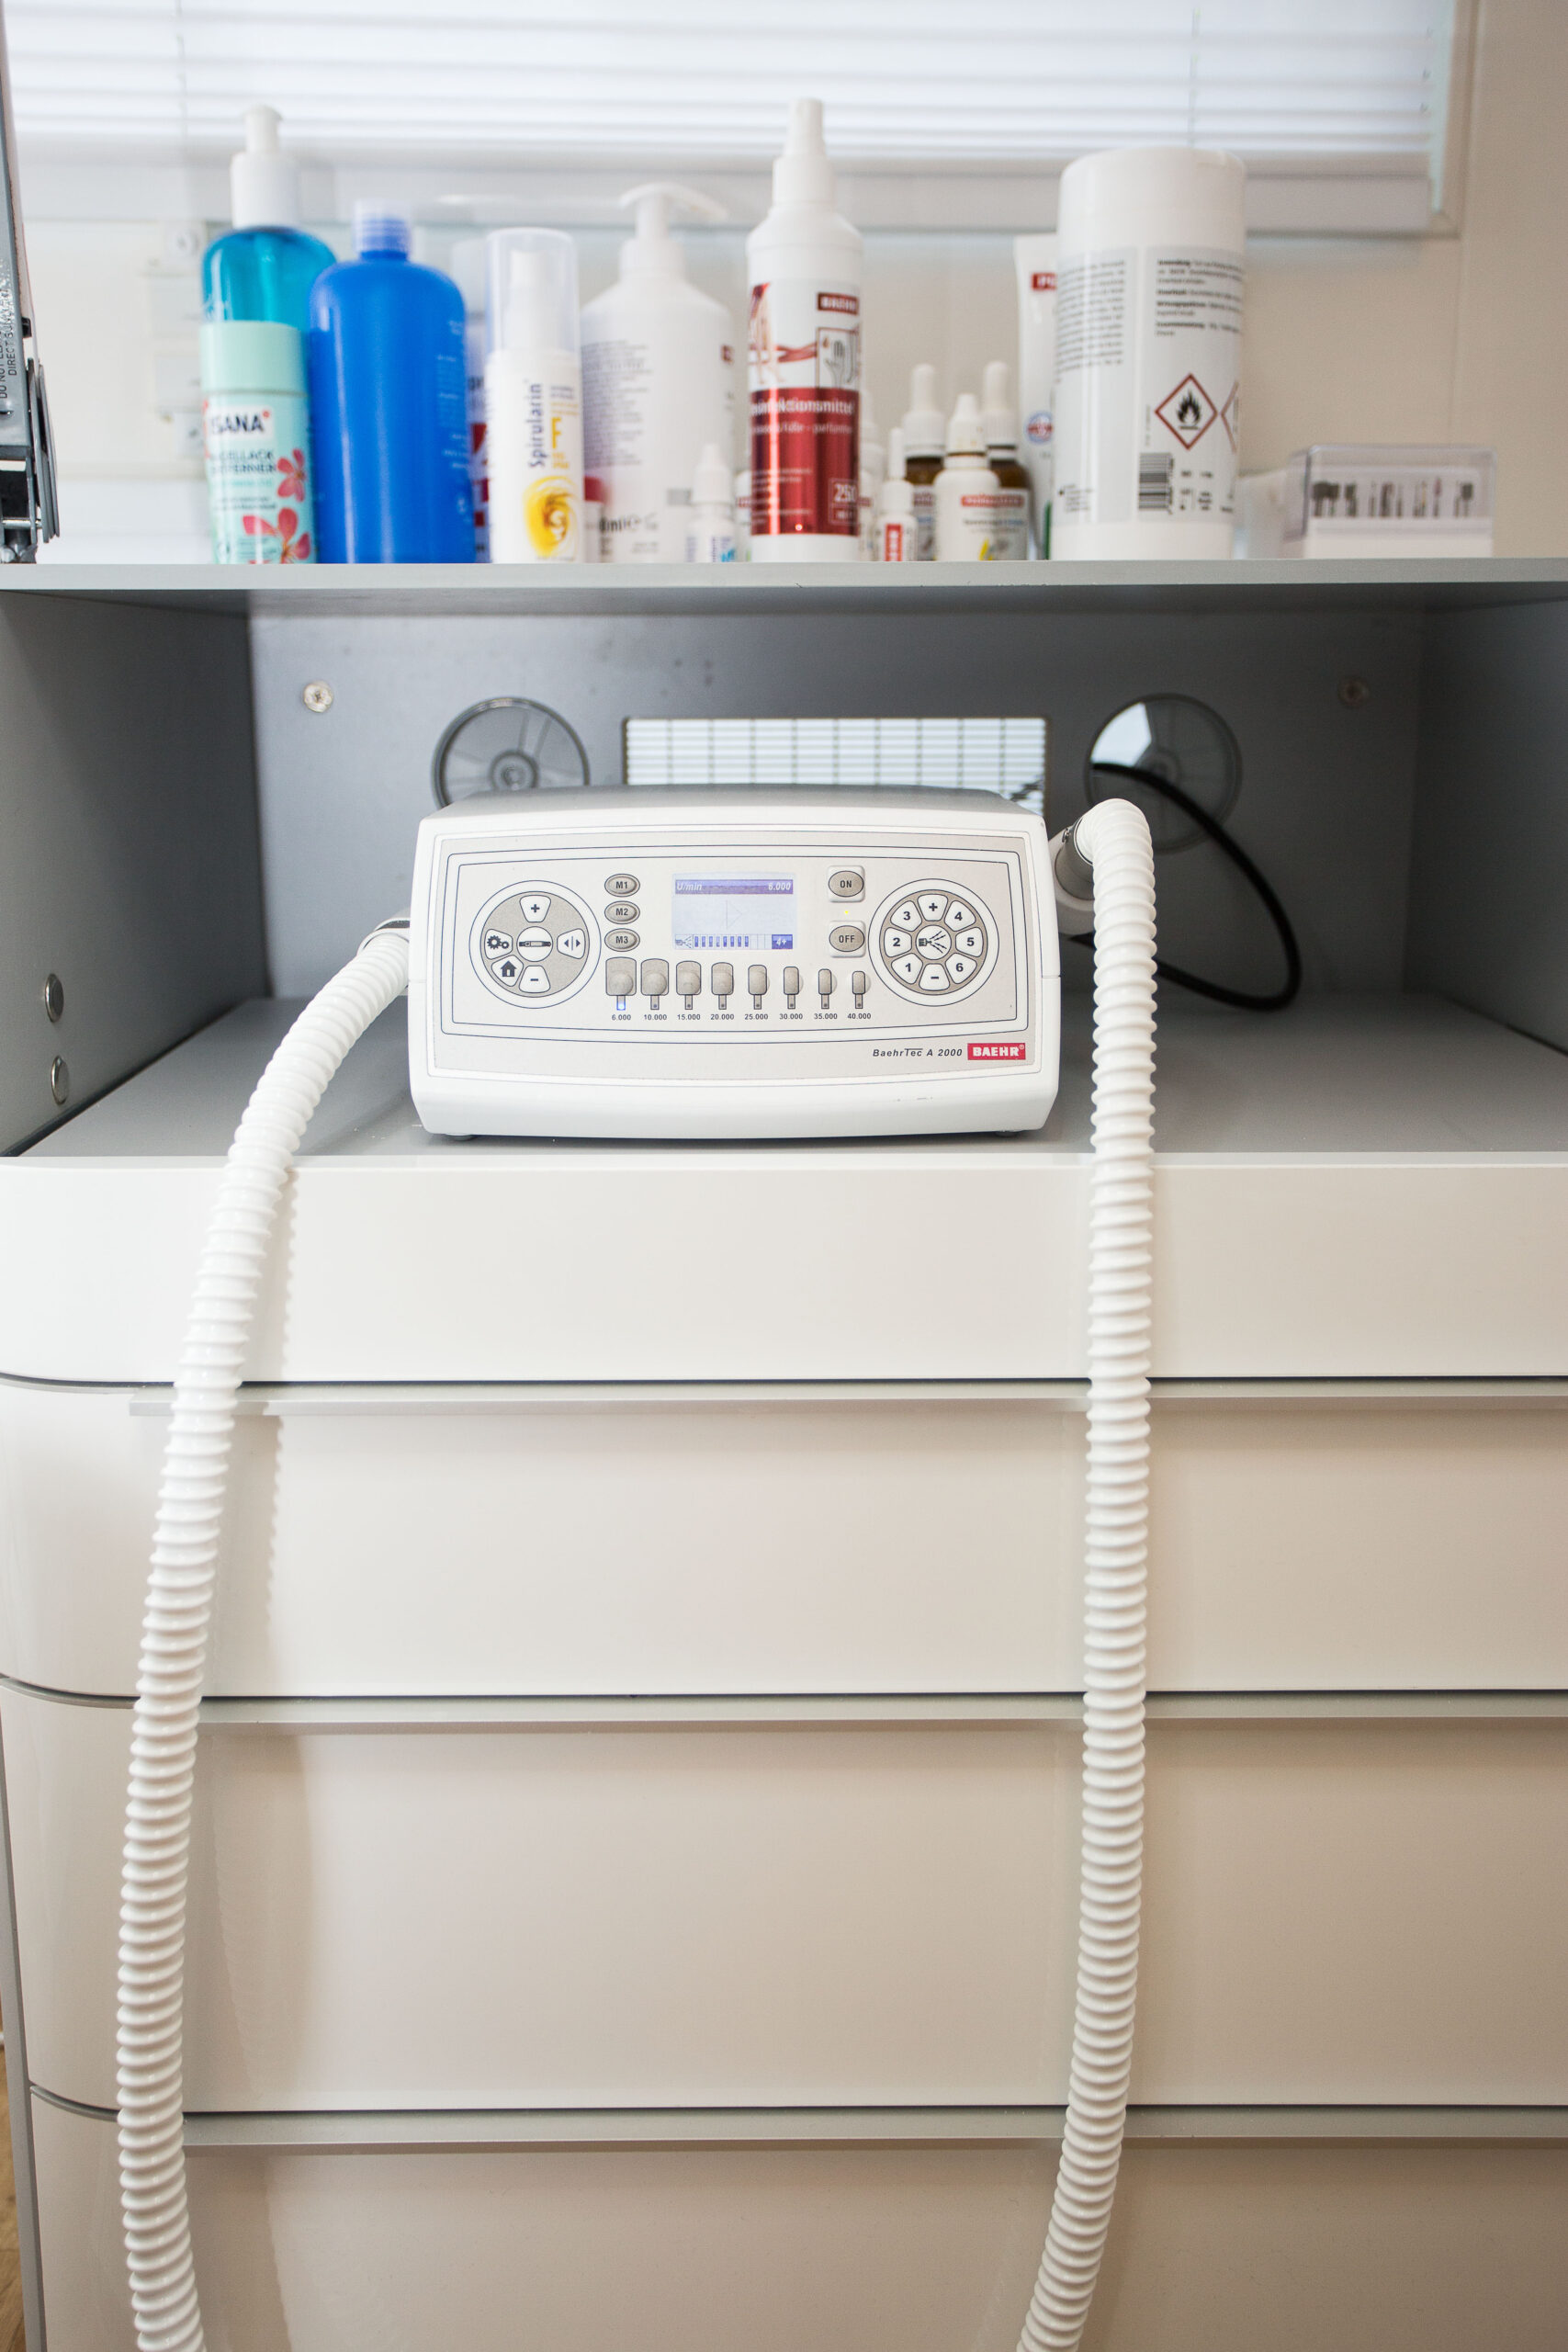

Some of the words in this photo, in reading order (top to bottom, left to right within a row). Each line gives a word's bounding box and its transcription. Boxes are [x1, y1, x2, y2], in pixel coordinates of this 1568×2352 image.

[6, 340, 17, 376] DIRECT
[615, 881, 628, 889] M1
[676, 882, 703, 891] U/min
[768, 882, 792, 891] 6.000
[840, 880, 852, 888] ON
[615, 908, 629, 916] M2
[903, 910, 911, 921] 3
[953, 911, 963, 921] 4
[615, 935, 629, 944] M3
[838, 934, 855, 943] OFF
[892, 937, 901, 947] 2
[966, 937, 975, 946] 5
[905, 963, 911, 972] 1
[955, 963, 964, 972] 6
[873, 1047, 923, 1057] BaehrTec
[926, 1048, 933, 1057] A
[937, 1048, 963, 1057] 2000
